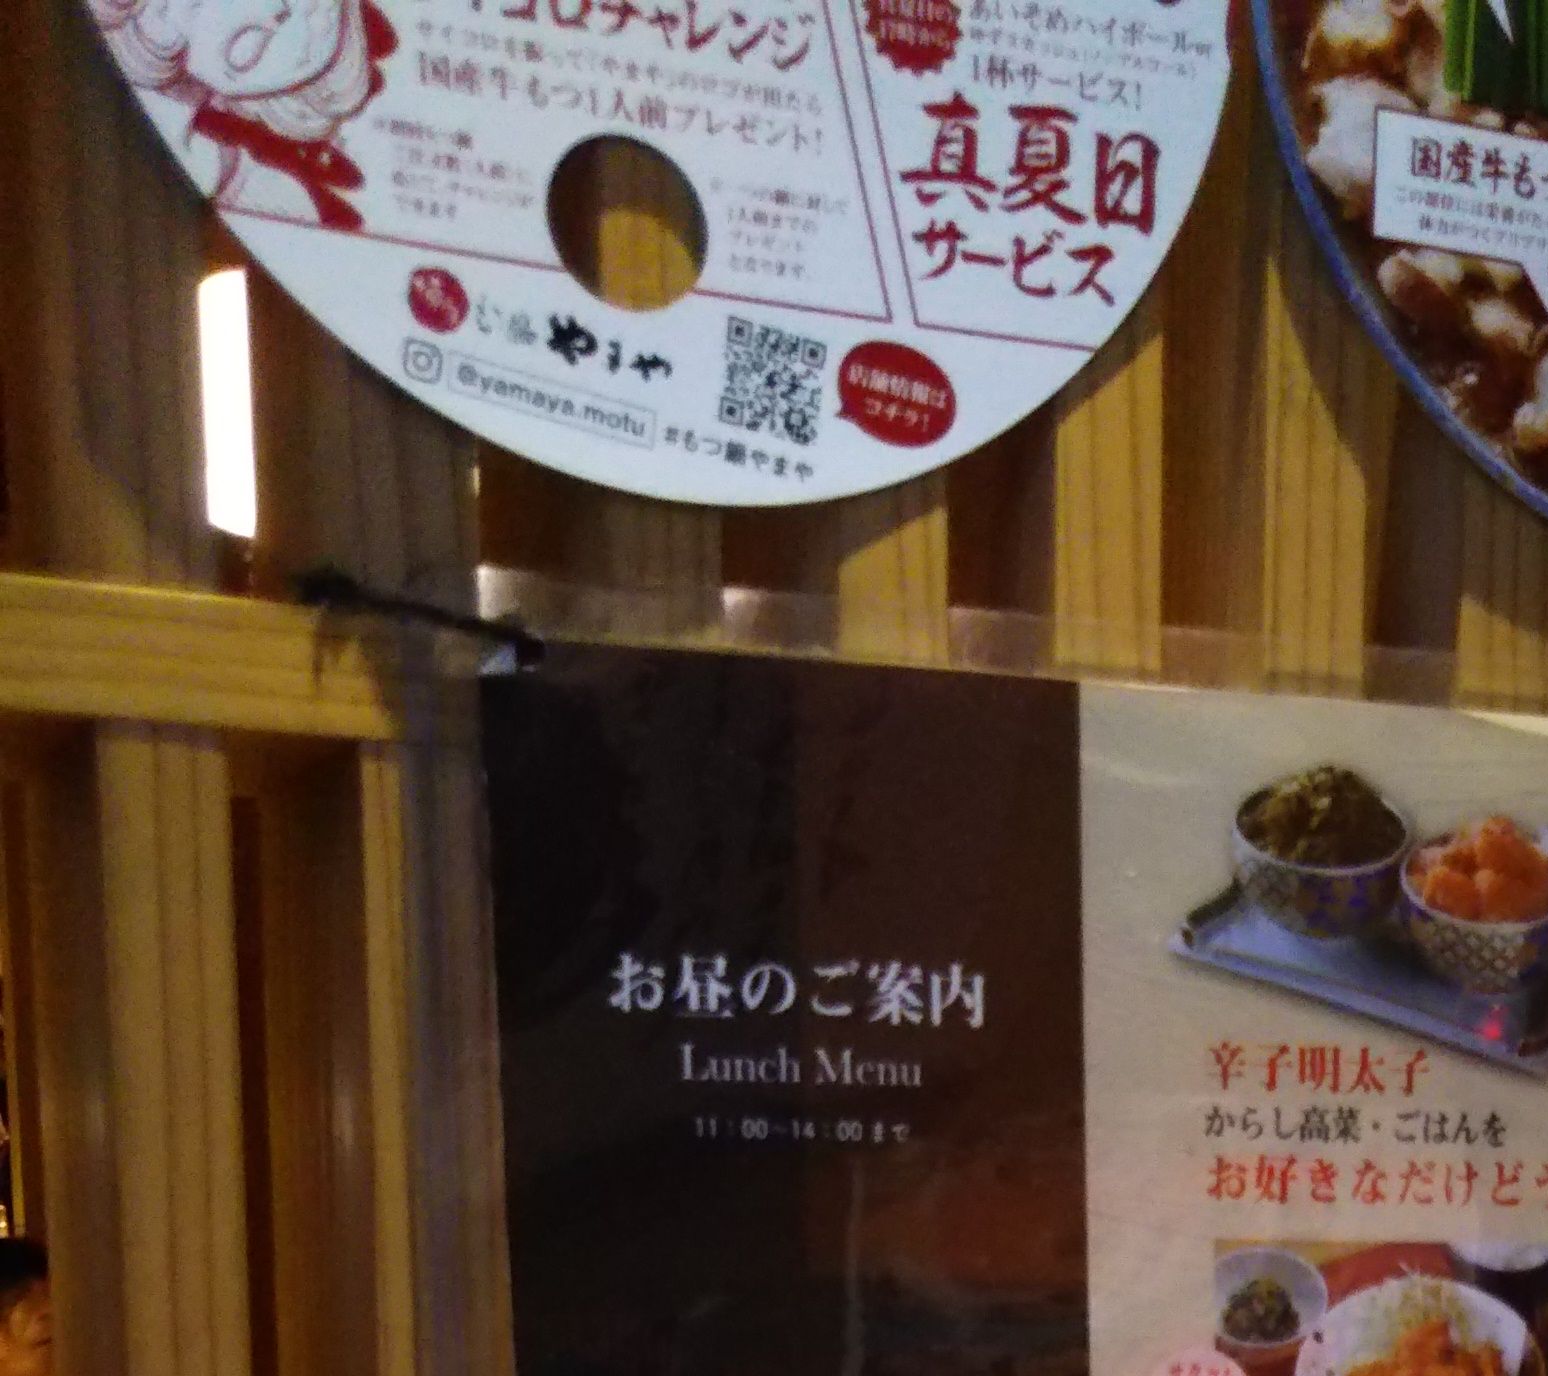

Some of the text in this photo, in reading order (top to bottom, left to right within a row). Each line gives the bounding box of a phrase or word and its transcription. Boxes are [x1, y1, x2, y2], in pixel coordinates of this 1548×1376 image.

[899, 90, 1162, 235] 真夏日
[911, 216, 1116, 307] サービス
[607, 950, 986, 1030] お昼のご案内
[680, 1043, 922, 1088] Lunch Menu
[1206, 1039, 1432, 1097] 辛子明太子
[1202, 1105, 1509, 1149] からし高菜・ごはんを
